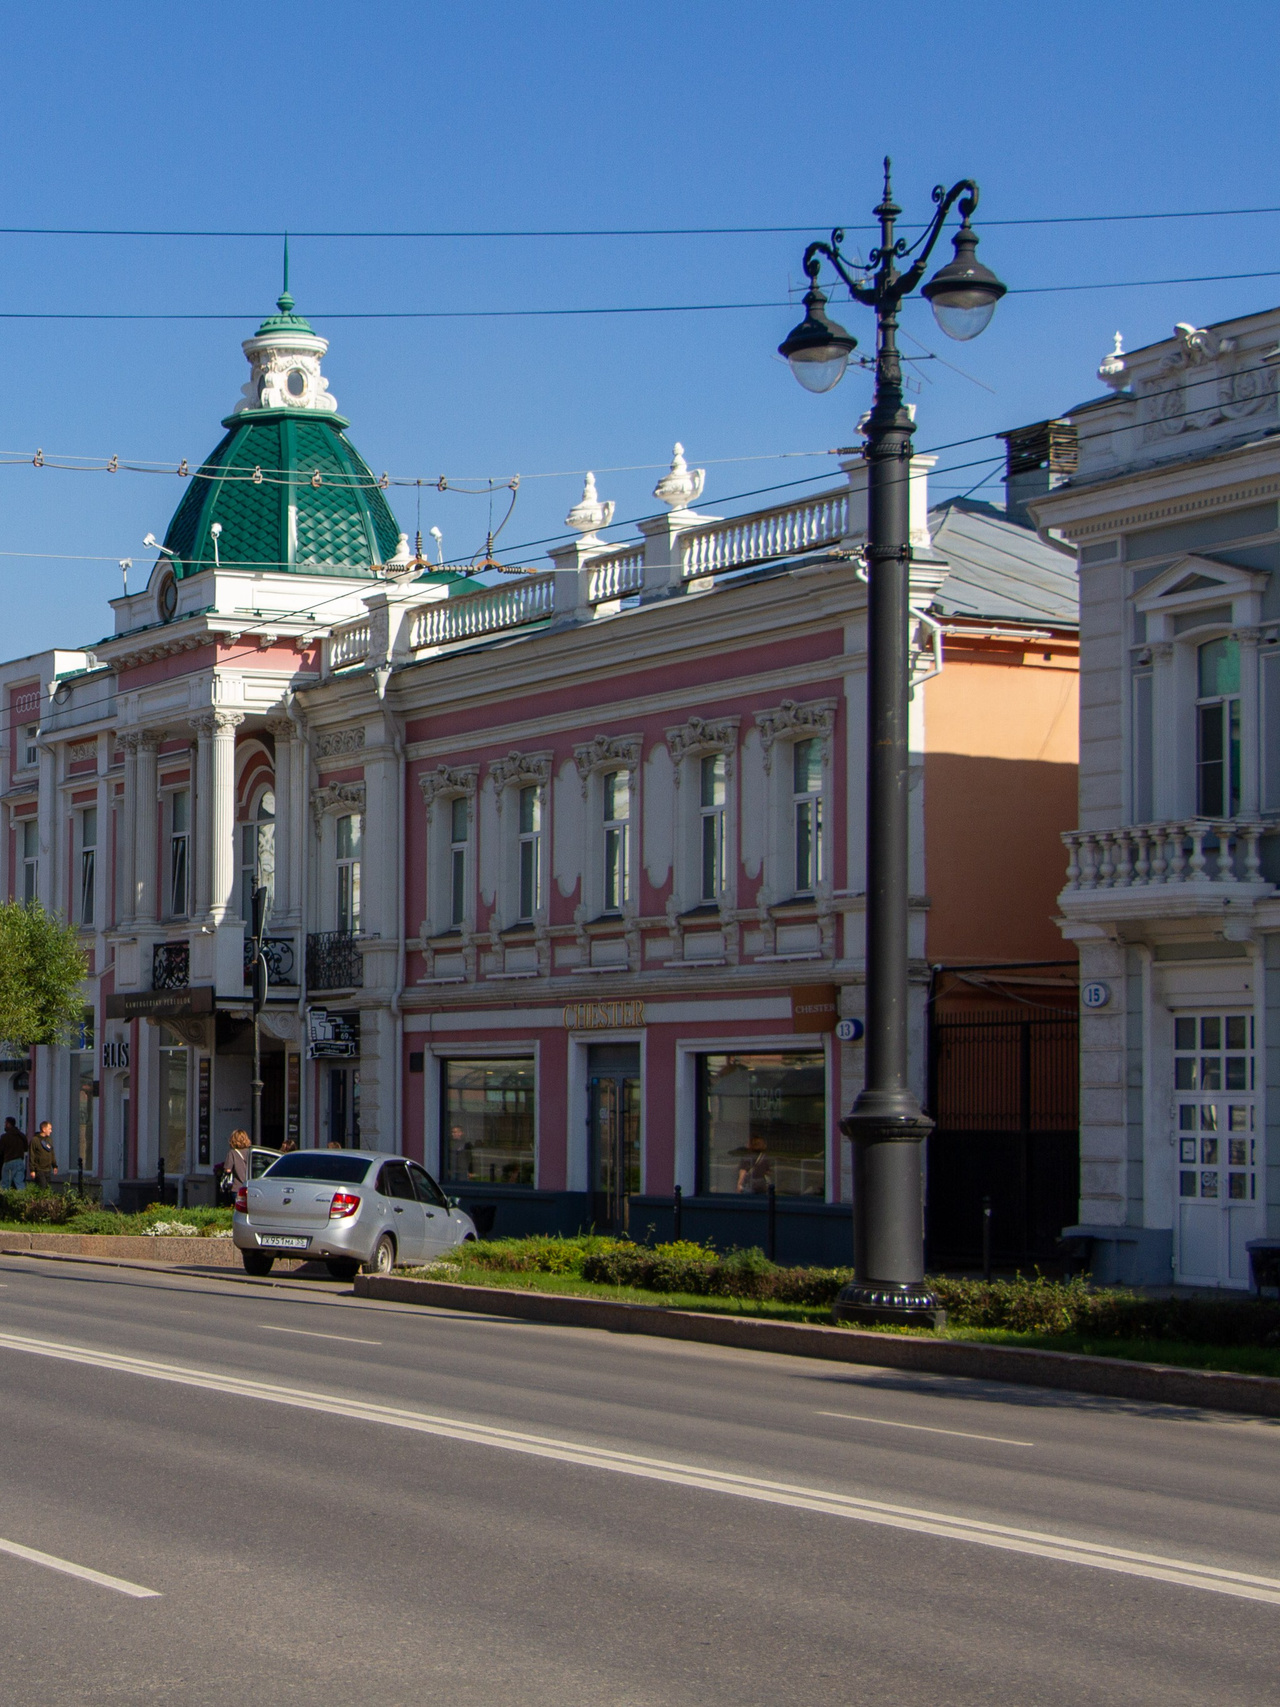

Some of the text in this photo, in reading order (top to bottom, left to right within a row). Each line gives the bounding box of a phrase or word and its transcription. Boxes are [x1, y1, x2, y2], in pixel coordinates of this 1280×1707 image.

[1088, 988, 1100, 1002] 15
[563, 999, 646, 1030] CHESTER
[795, 1003, 835, 1014] CHESTER
[839, 1023, 851, 1037] 13
[102, 1042, 129, 1068] ELIS
